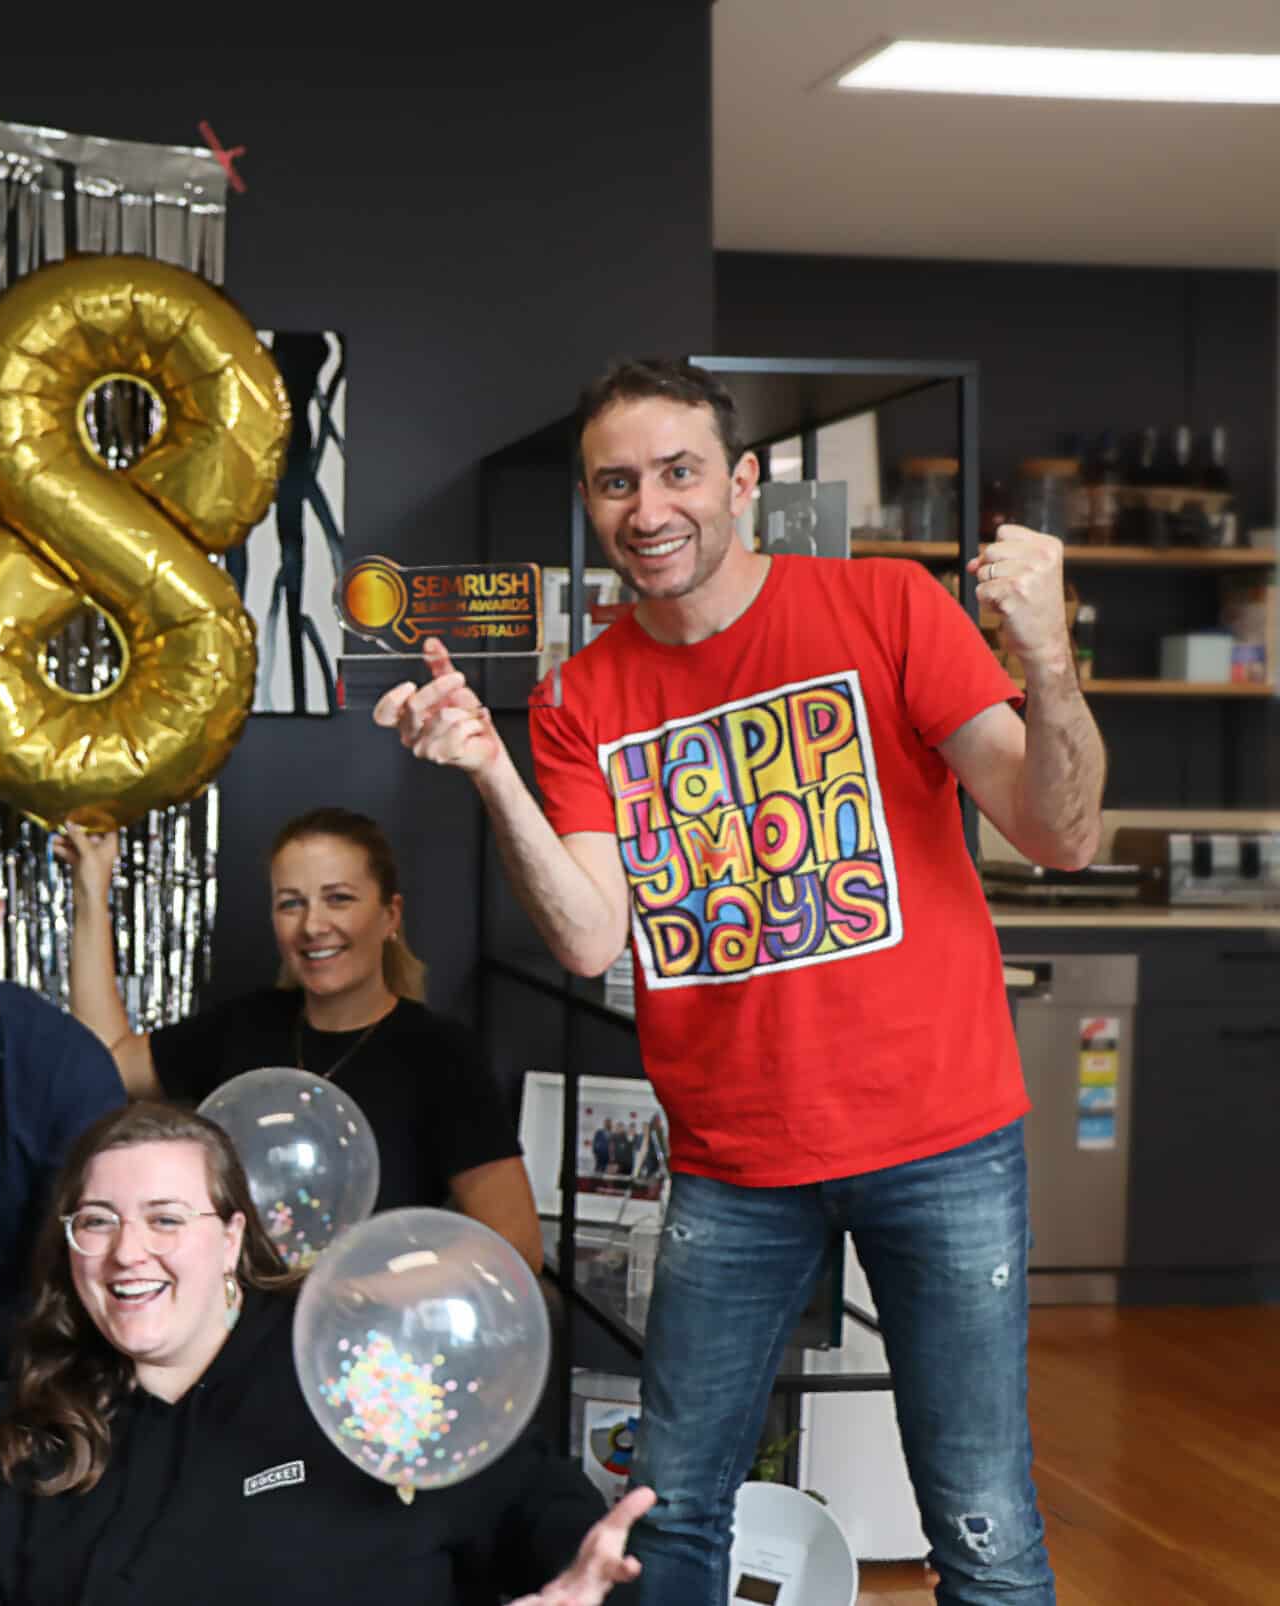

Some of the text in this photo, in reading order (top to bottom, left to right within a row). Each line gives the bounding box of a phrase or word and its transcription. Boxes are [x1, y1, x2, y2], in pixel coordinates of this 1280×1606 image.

[412, 572, 529, 598] SEMRUSH
[469, 598, 529, 612] AWARDS
[450, 624, 529, 638] AUSTRALIA
